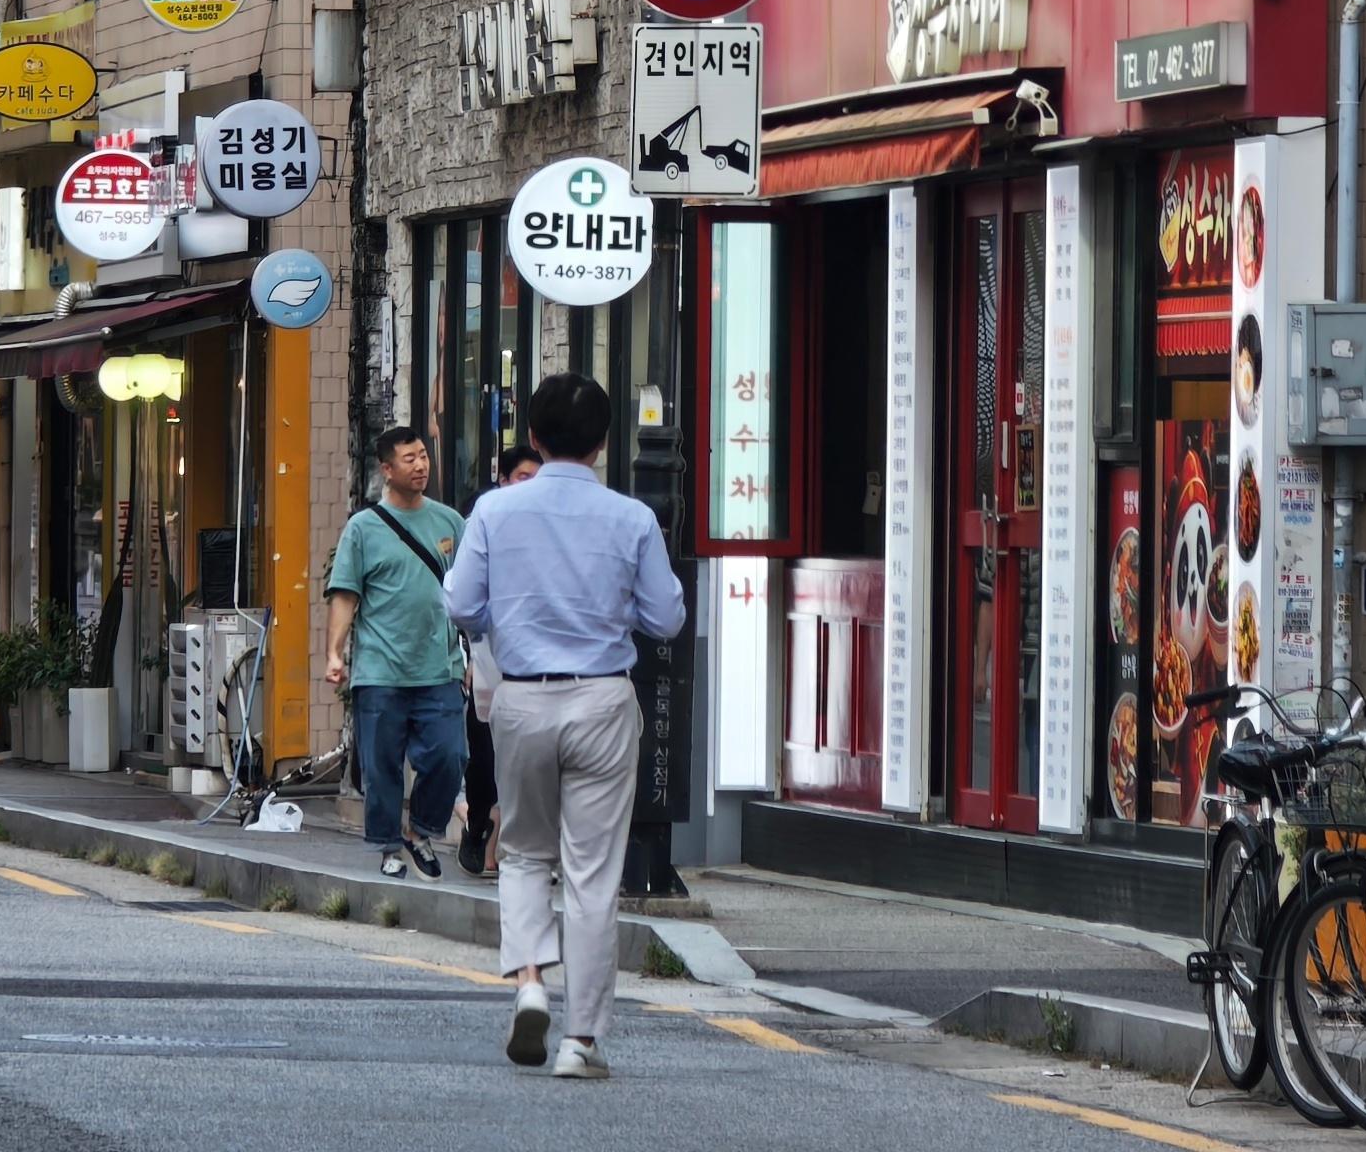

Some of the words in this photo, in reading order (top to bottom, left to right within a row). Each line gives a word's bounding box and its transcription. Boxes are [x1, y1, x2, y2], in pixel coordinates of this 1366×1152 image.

[1123, 55, 1143, 89] TEL.
[218, 126, 306, 155] 김성기
[219, 161, 307, 191] 미용실
[75, 210, 152, 224] 467-5955
[1180, 163, 1233, 266] 성수차
[524, 211, 647, 253] 양내과
[535, 264, 549, 278] T.
[554, 264, 633, 282] 469-3871
